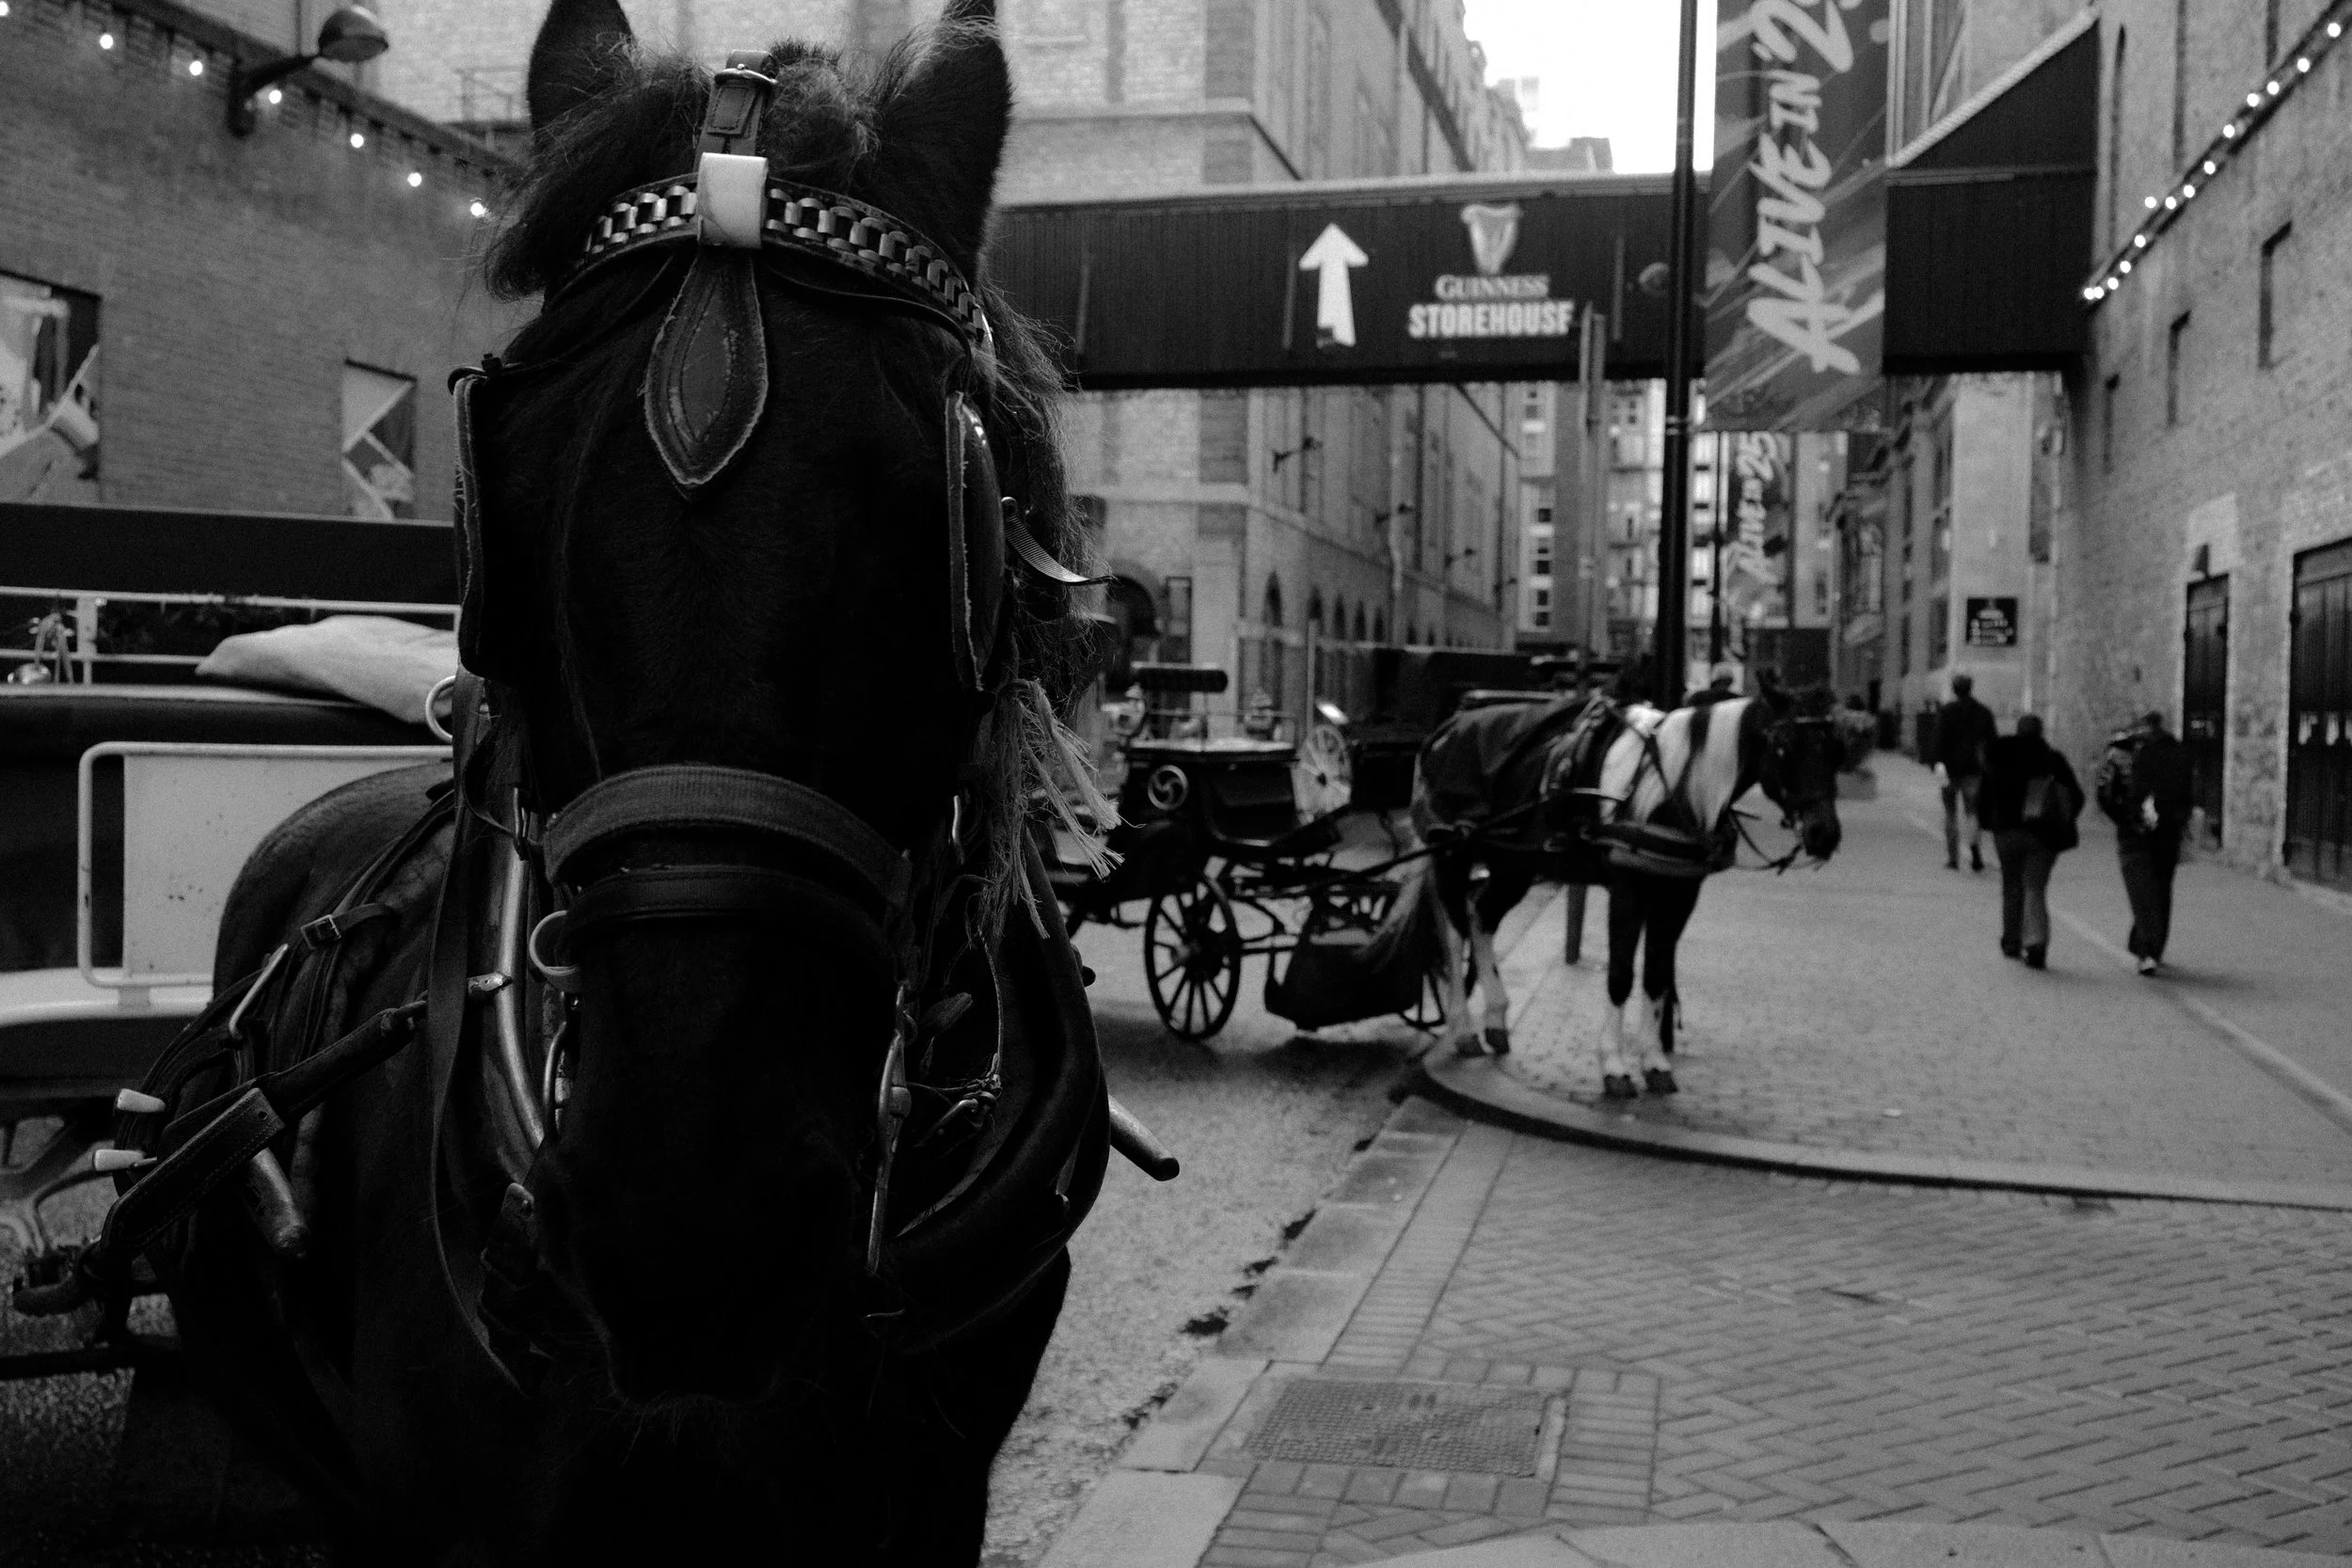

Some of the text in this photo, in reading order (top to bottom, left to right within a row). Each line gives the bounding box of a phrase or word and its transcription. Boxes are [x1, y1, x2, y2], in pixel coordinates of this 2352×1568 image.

[1767, 71, 1821, 134] IN
[1747, 133, 1860, 373] ALIVE
[1435, 274, 1549, 300] GUINNESS
[1408, 300, 1575, 339] STOREHOUSE
